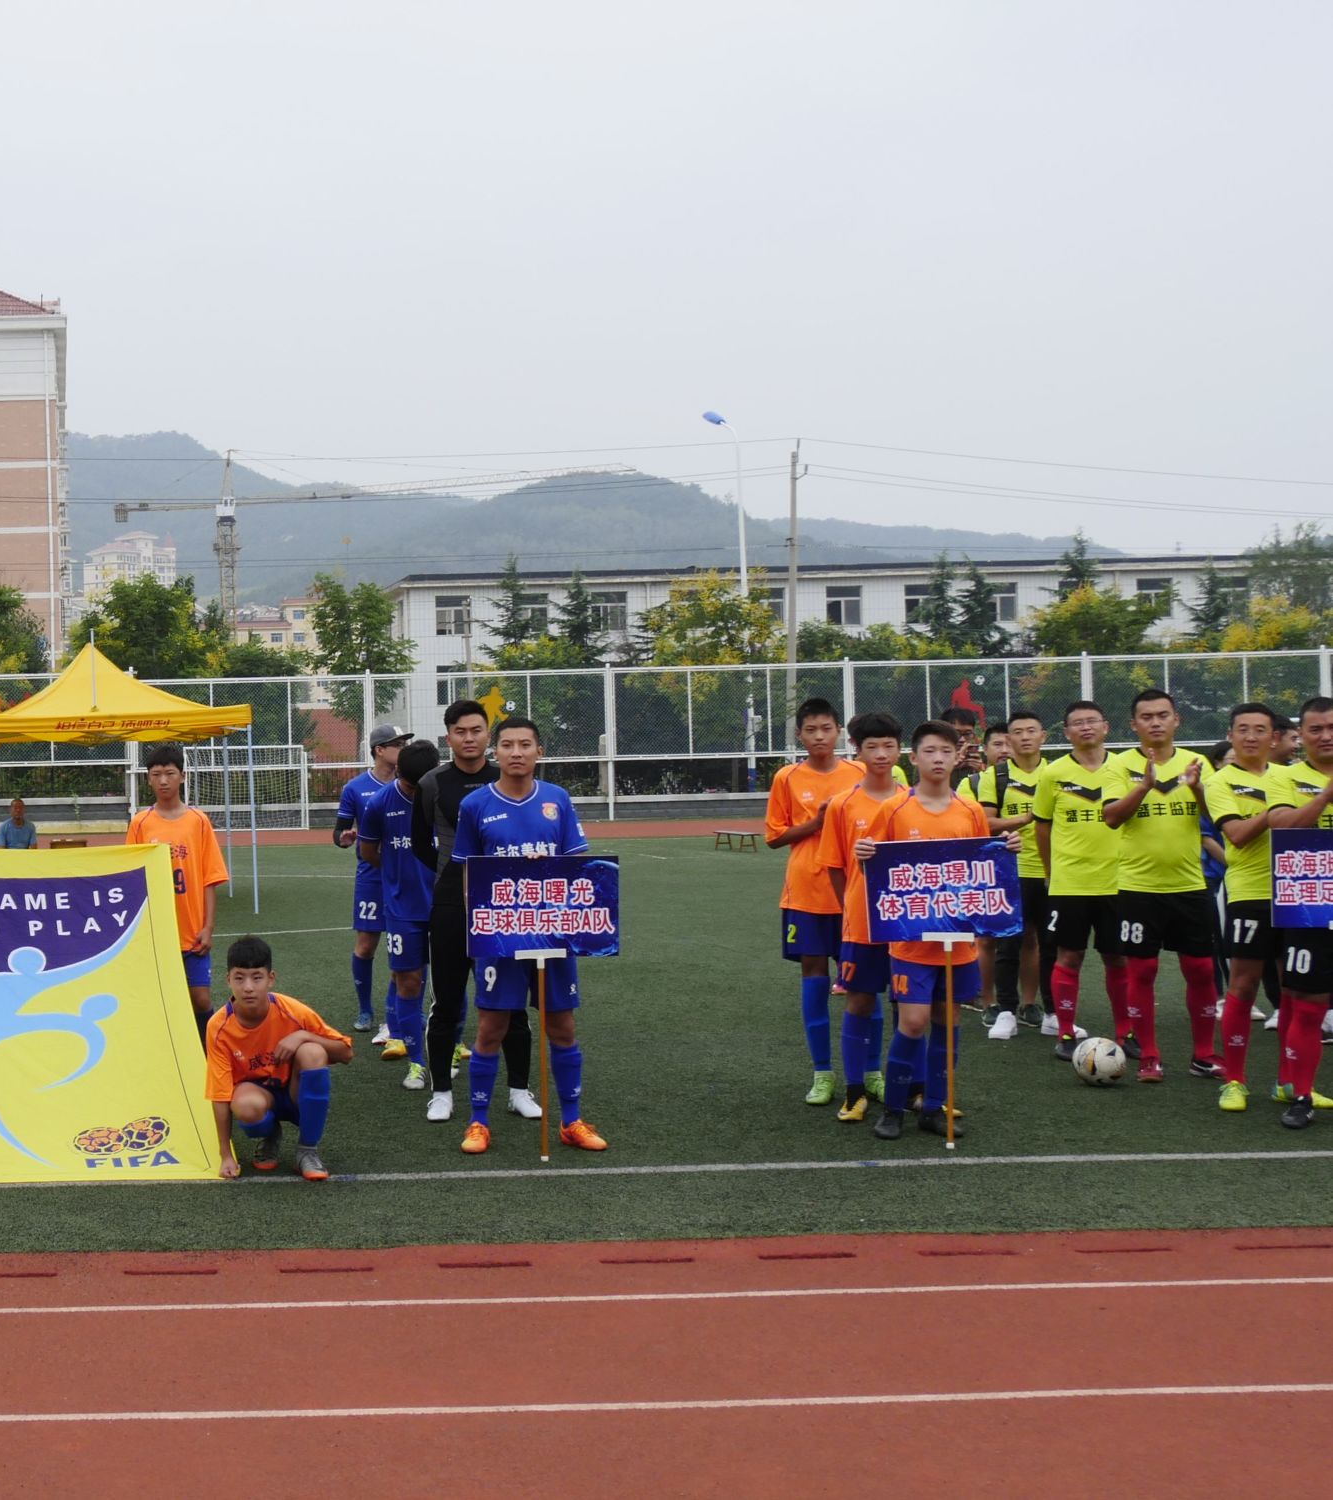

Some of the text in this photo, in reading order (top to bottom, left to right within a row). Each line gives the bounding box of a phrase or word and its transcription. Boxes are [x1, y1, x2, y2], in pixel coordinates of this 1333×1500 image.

[173, 868, 186, 894] 9
[888, 860, 996, 892] 威海璟川
[93, 887, 125, 907] IS
[491, 878, 595, 905] 威海曙光
[877, 888, 1014, 921] 体育代表队
[28, 910, 128, 937] PLAY
[359, 901, 377, 920] 22
[470, 908, 615, 936] 足球俱乐部A队
[1047, 910, 1058, 932] 2
[787, 924, 797, 943] 2
[1120, 920, 1144, 944] 88
[1233, 918, 1259, 944] 17
[1286, 946, 1312, 974] 10
[484, 966, 497, 992] 9
[85, 1150, 180, 1168] FIFA
